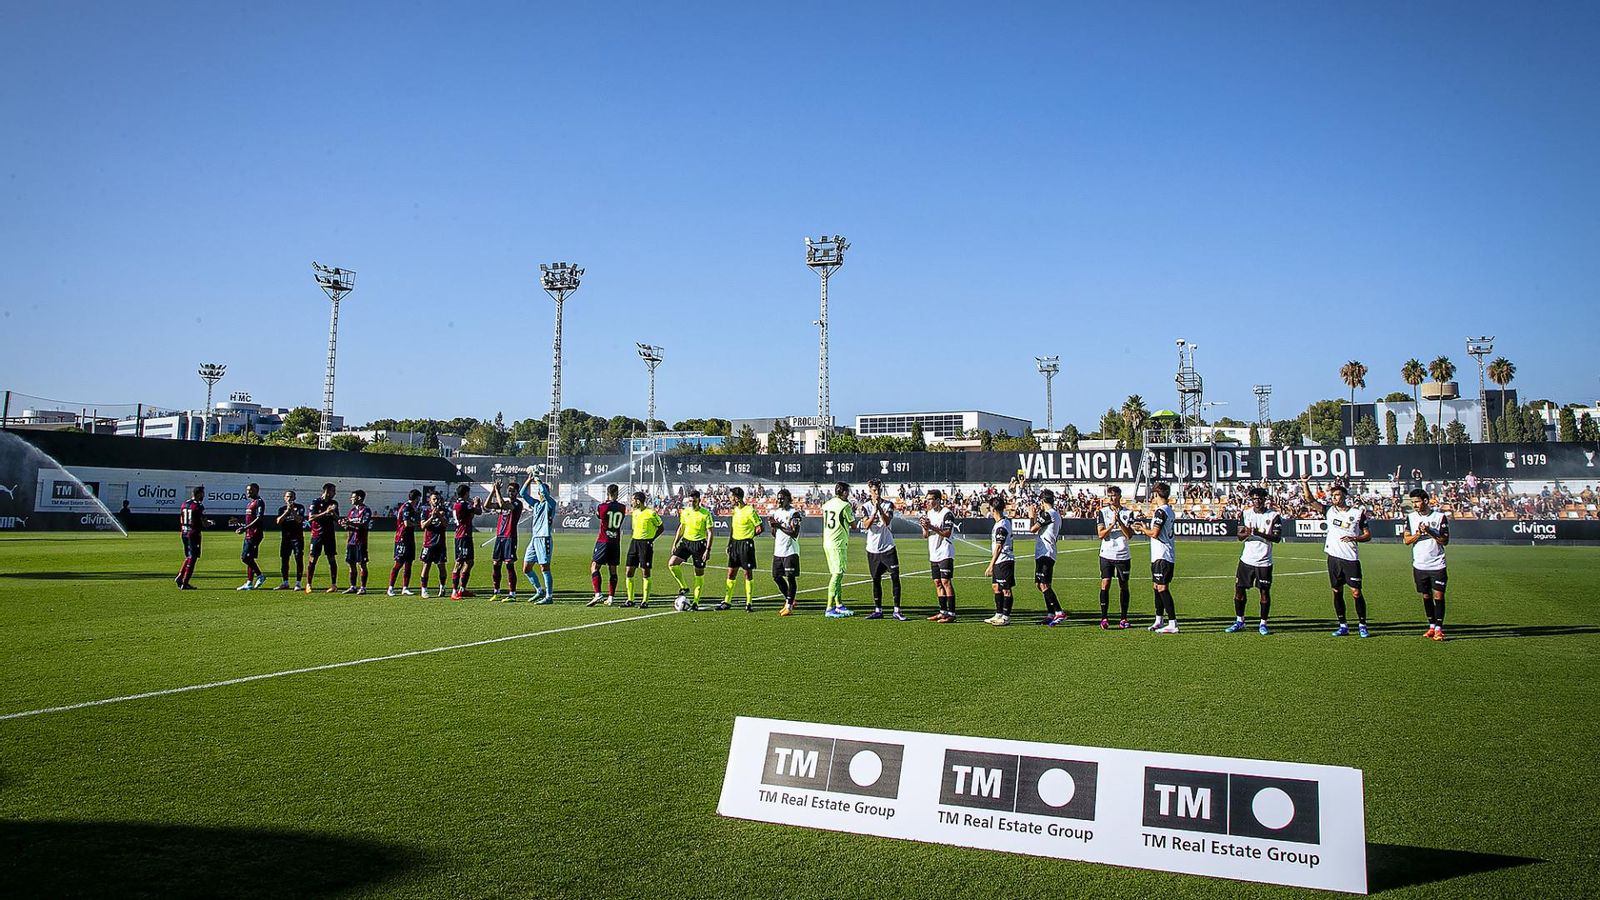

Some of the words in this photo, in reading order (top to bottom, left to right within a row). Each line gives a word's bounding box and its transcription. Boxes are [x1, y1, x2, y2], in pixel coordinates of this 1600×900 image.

[1019, 452, 1134, 479] VALENCIA
[1144, 451, 1207, 479] CLUB
[1218, 450, 1250, 478] DE
[1261, 446, 1364, 478] FÚTBOL
[1520, 454, 1547, 465] 1979
[594, 464, 609, 473] 1947
[686, 464, 702, 473] 1954
[734, 464, 750, 473] 1962
[784, 463, 800, 472] 1963
[837, 463, 854, 472] 1967
[892, 462, 910, 472] 1971
[55, 485, 72, 495] TM
[138, 484, 177, 498] divina
[183, 509, 193, 524] 11
[606, 511, 623, 529] 10
[824, 510, 836, 529] 13
[1173, 522, 1227, 535] UCHADES
[1512, 522, 1556, 534] divina
[775, 747, 819, 778] TM
[952, 765, 1003, 799] TM
[758, 789, 778, 803] TM
[781, 794, 807, 807] Real
[811, 796, 850, 812] Estate
[854, 802, 895, 820] Group
[1154, 784, 1211, 820] TM
[938, 811, 959, 825] TM
[964, 814, 993, 829] Real
[998, 818, 1042, 835] Estate
[1047, 823, 1094, 843] Group
[1142, 833, 1166, 848] TM
[1172, 837, 1205, 853] Real
[1211, 840, 1261, 859] Estate
[1267, 847, 1320, 868] Group
